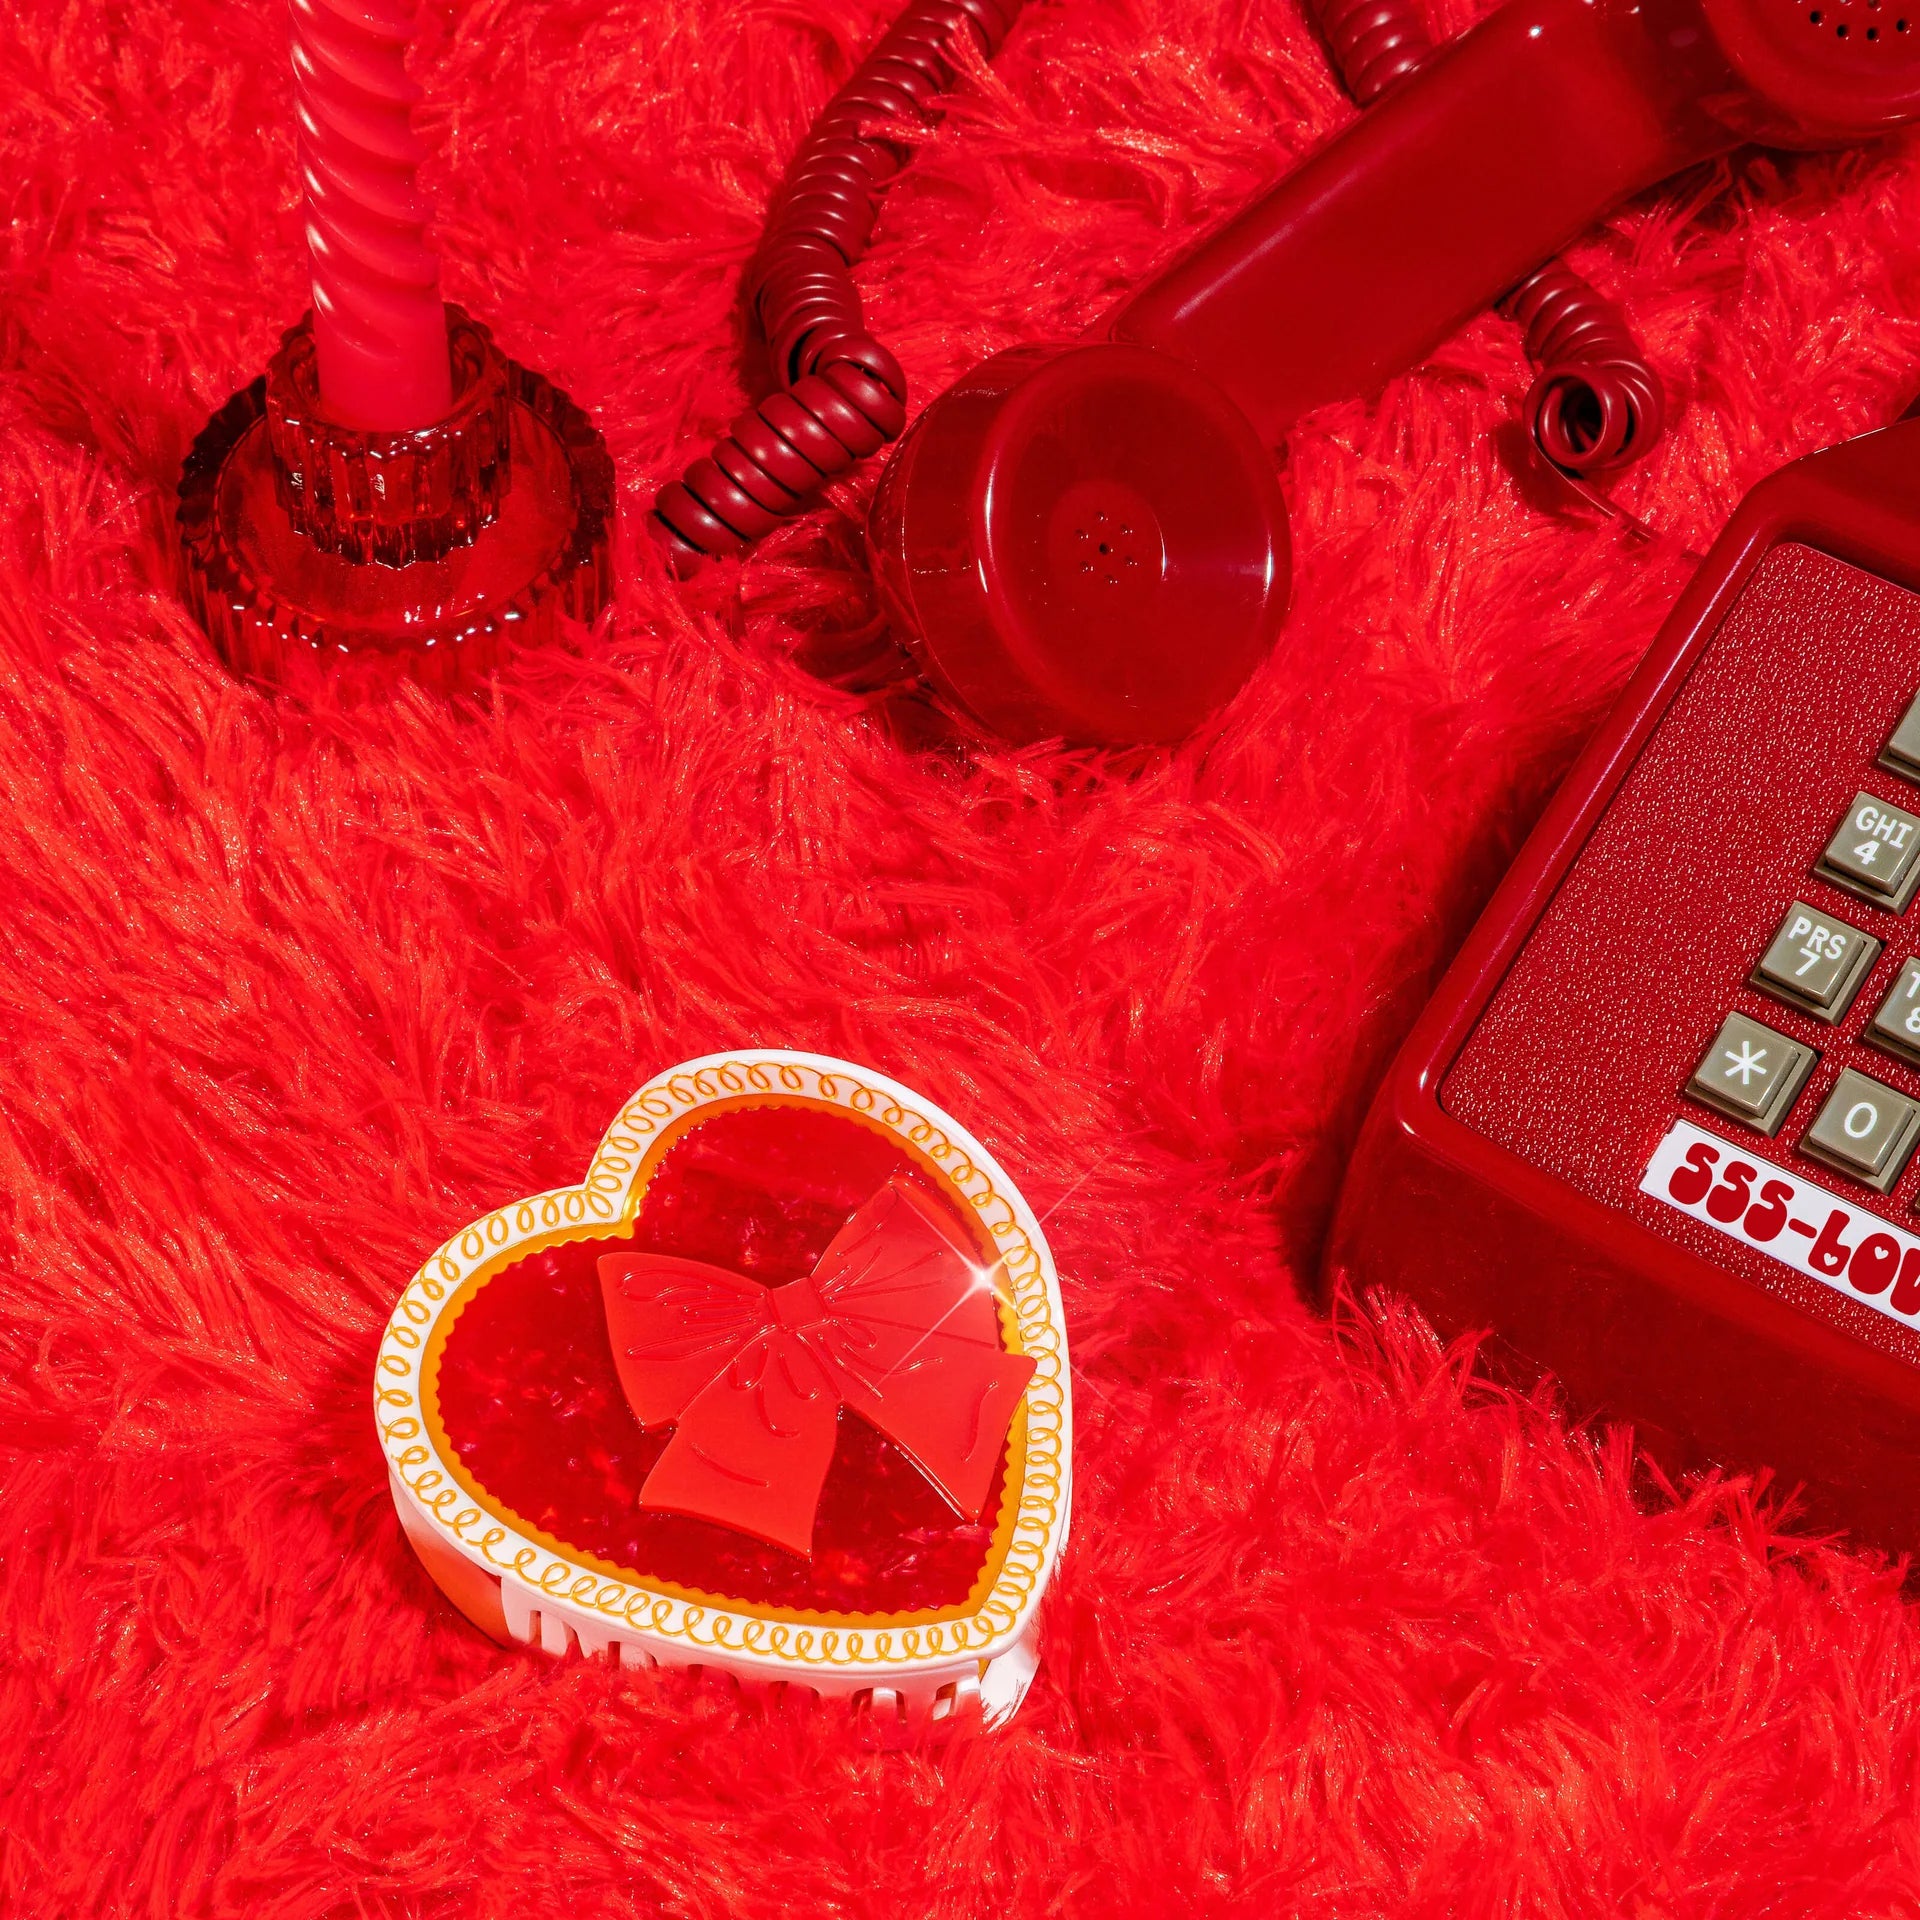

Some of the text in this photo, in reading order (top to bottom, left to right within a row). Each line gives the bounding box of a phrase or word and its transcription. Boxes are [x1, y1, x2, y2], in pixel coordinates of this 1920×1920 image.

[1855, 807, 1913, 849] GHI
[1853, 840, 1880, 865] 4
[1787, 916, 1847, 960] PRS
[1795, 947, 1821, 976] 7
